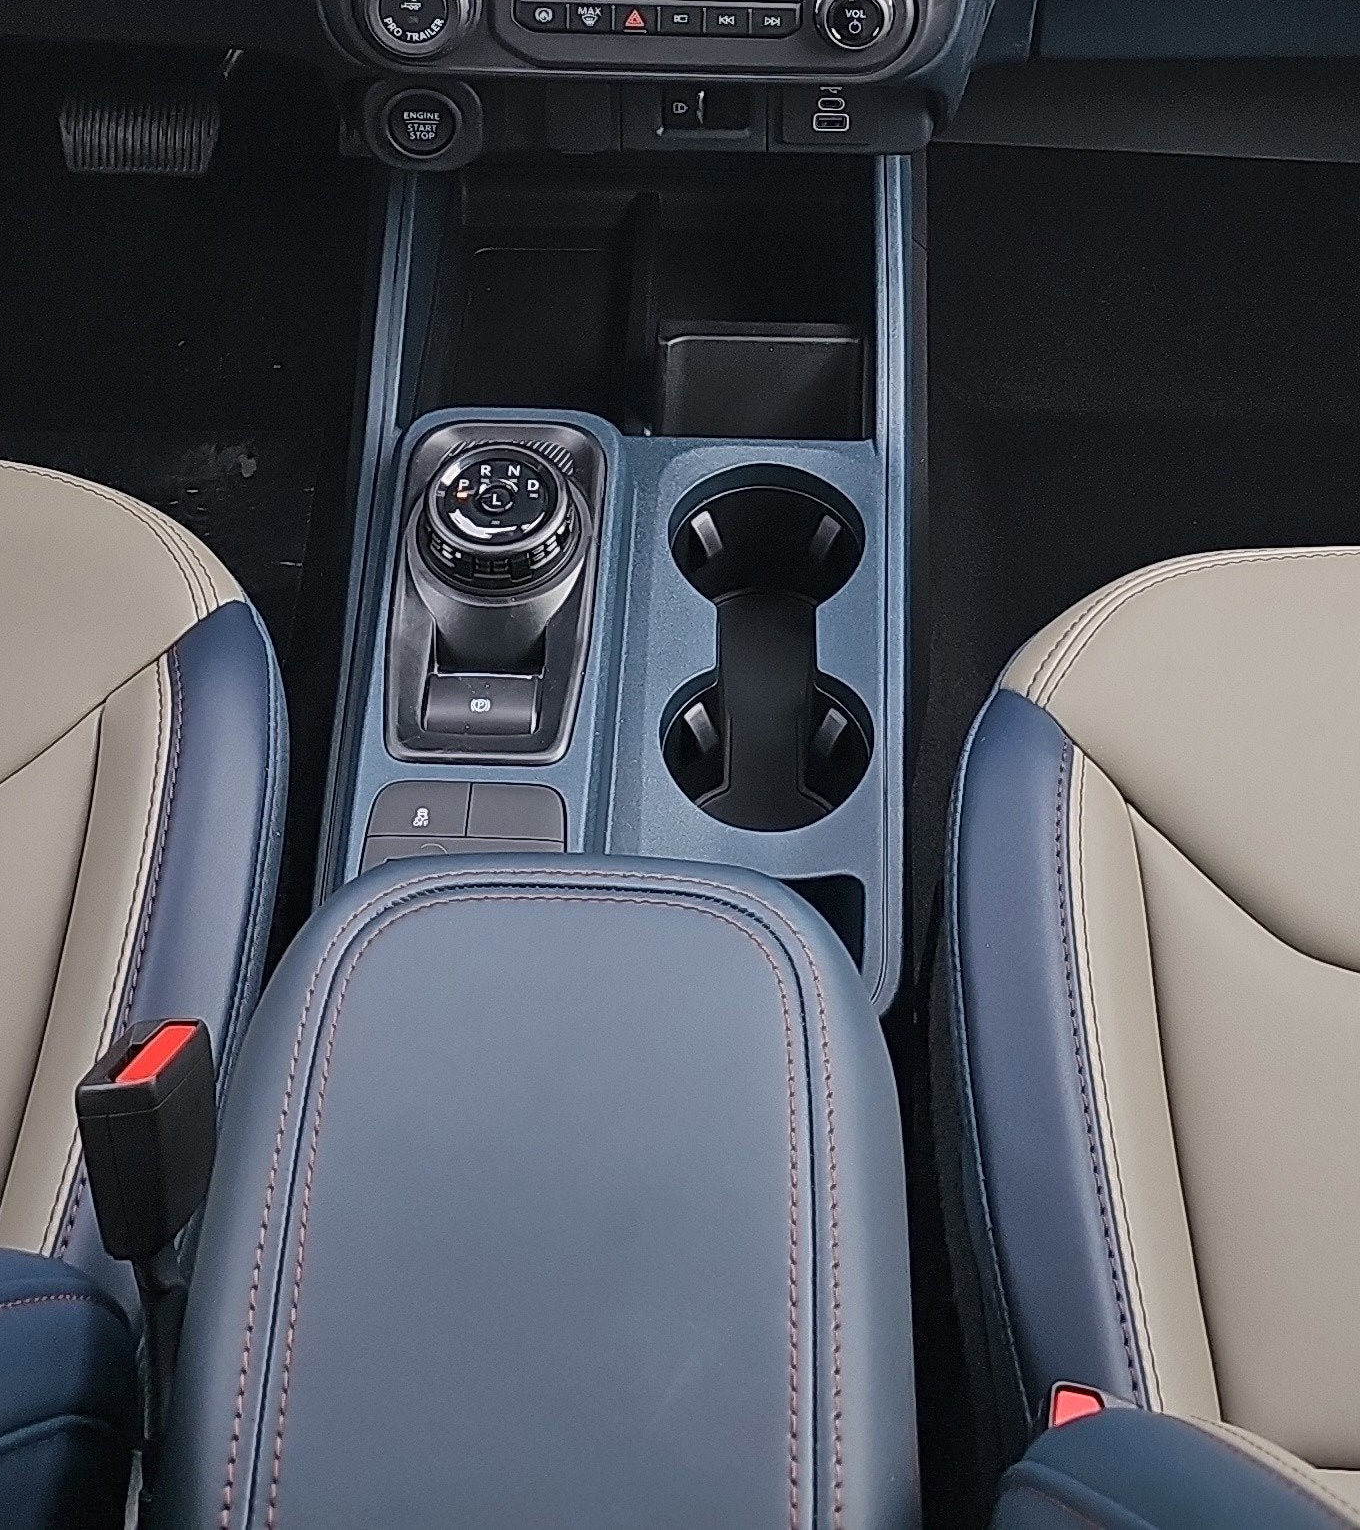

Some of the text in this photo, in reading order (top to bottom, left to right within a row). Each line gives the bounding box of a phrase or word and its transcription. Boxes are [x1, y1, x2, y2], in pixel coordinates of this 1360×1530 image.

[578, 7, 602, 16] MAX
[845, 9, 866, 19] VOL
[384, 17, 444, 41] PRO TRAILER
[404, 112, 440, 120] ENGINE
[407, 124, 437, 132] START
[409, 131, 435, 140] STOP
[480, 465, 492, 476] R
[507, 465, 521, 476] N
[458, 479, 470, 490] P
[527, 480, 540, 491] D
[492, 494, 502, 505] L
